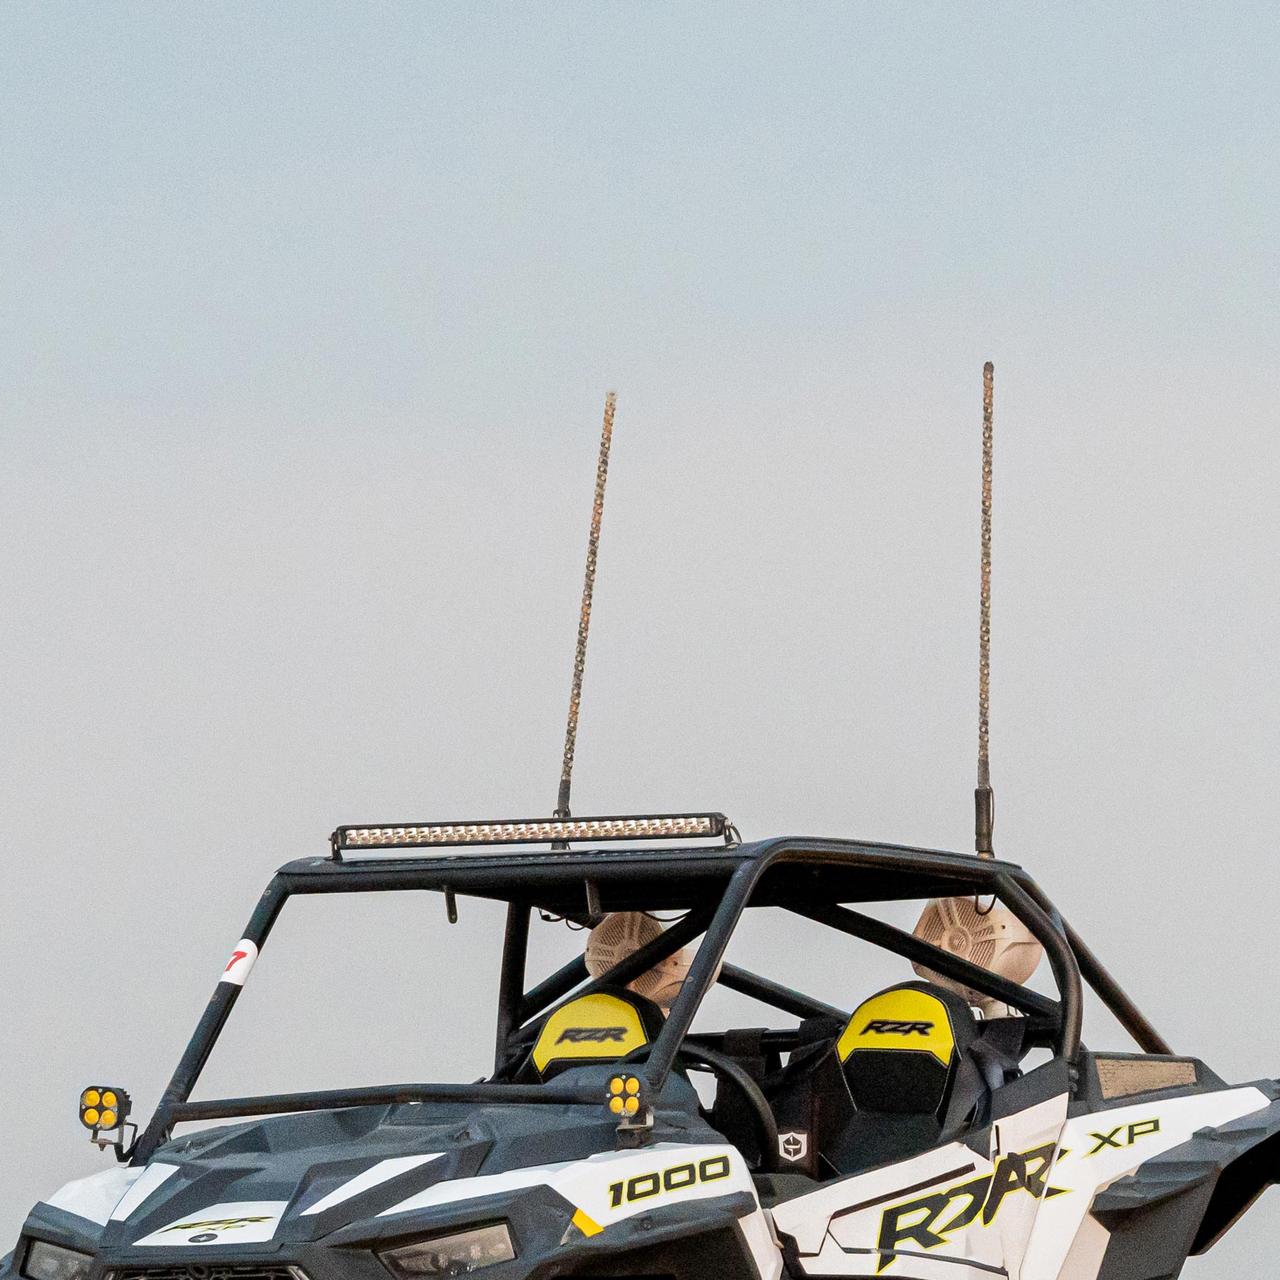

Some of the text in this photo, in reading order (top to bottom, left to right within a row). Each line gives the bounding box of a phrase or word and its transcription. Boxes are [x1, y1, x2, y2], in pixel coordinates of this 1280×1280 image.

[554, 1026, 628, 1046] RZR
[858, 1019, 935, 1036] RZR
[1083, 1117, 1161, 1157] XP
[608, 1154, 731, 1208] 1000
